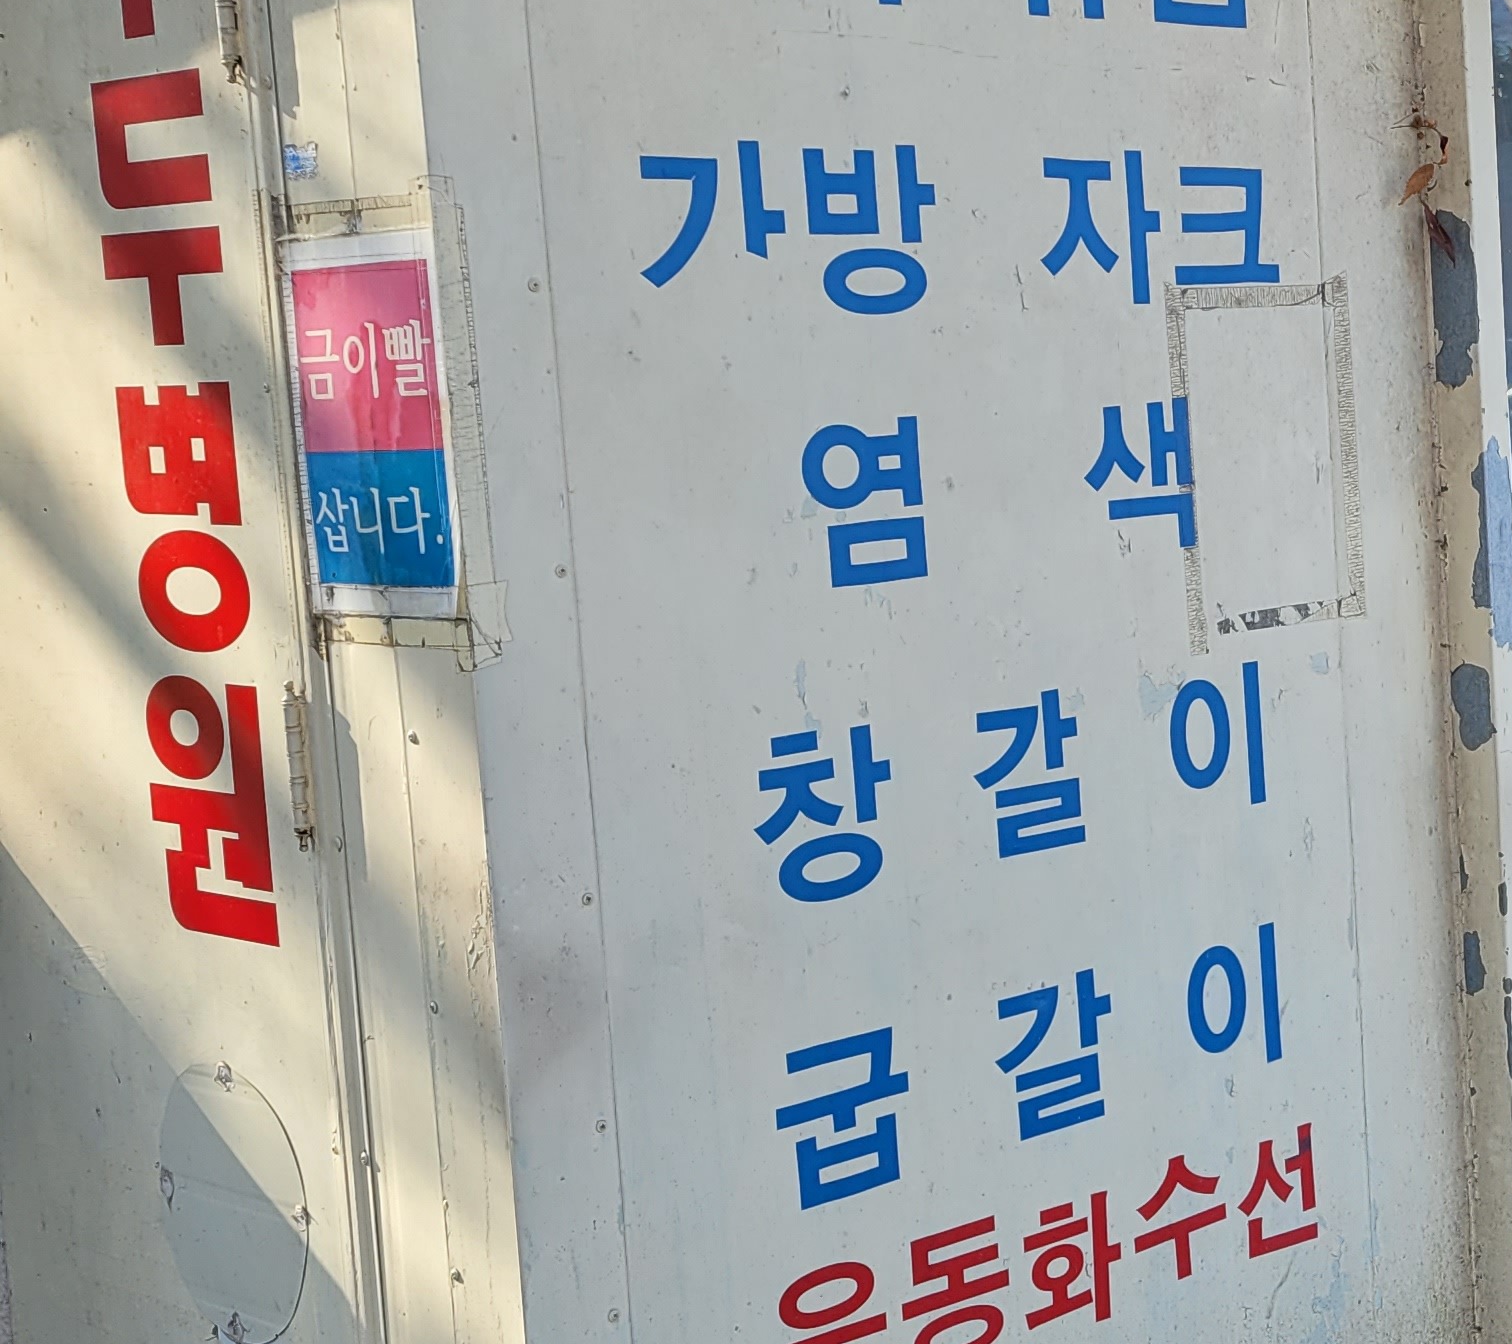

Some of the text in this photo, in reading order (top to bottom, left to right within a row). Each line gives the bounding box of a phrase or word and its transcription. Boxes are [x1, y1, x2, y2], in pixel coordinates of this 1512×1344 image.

[639, 140, 1280, 315] 가방 자크
[300, 318, 431, 400] 금이빨
[316, 486, 445, 555] 삽니다.
